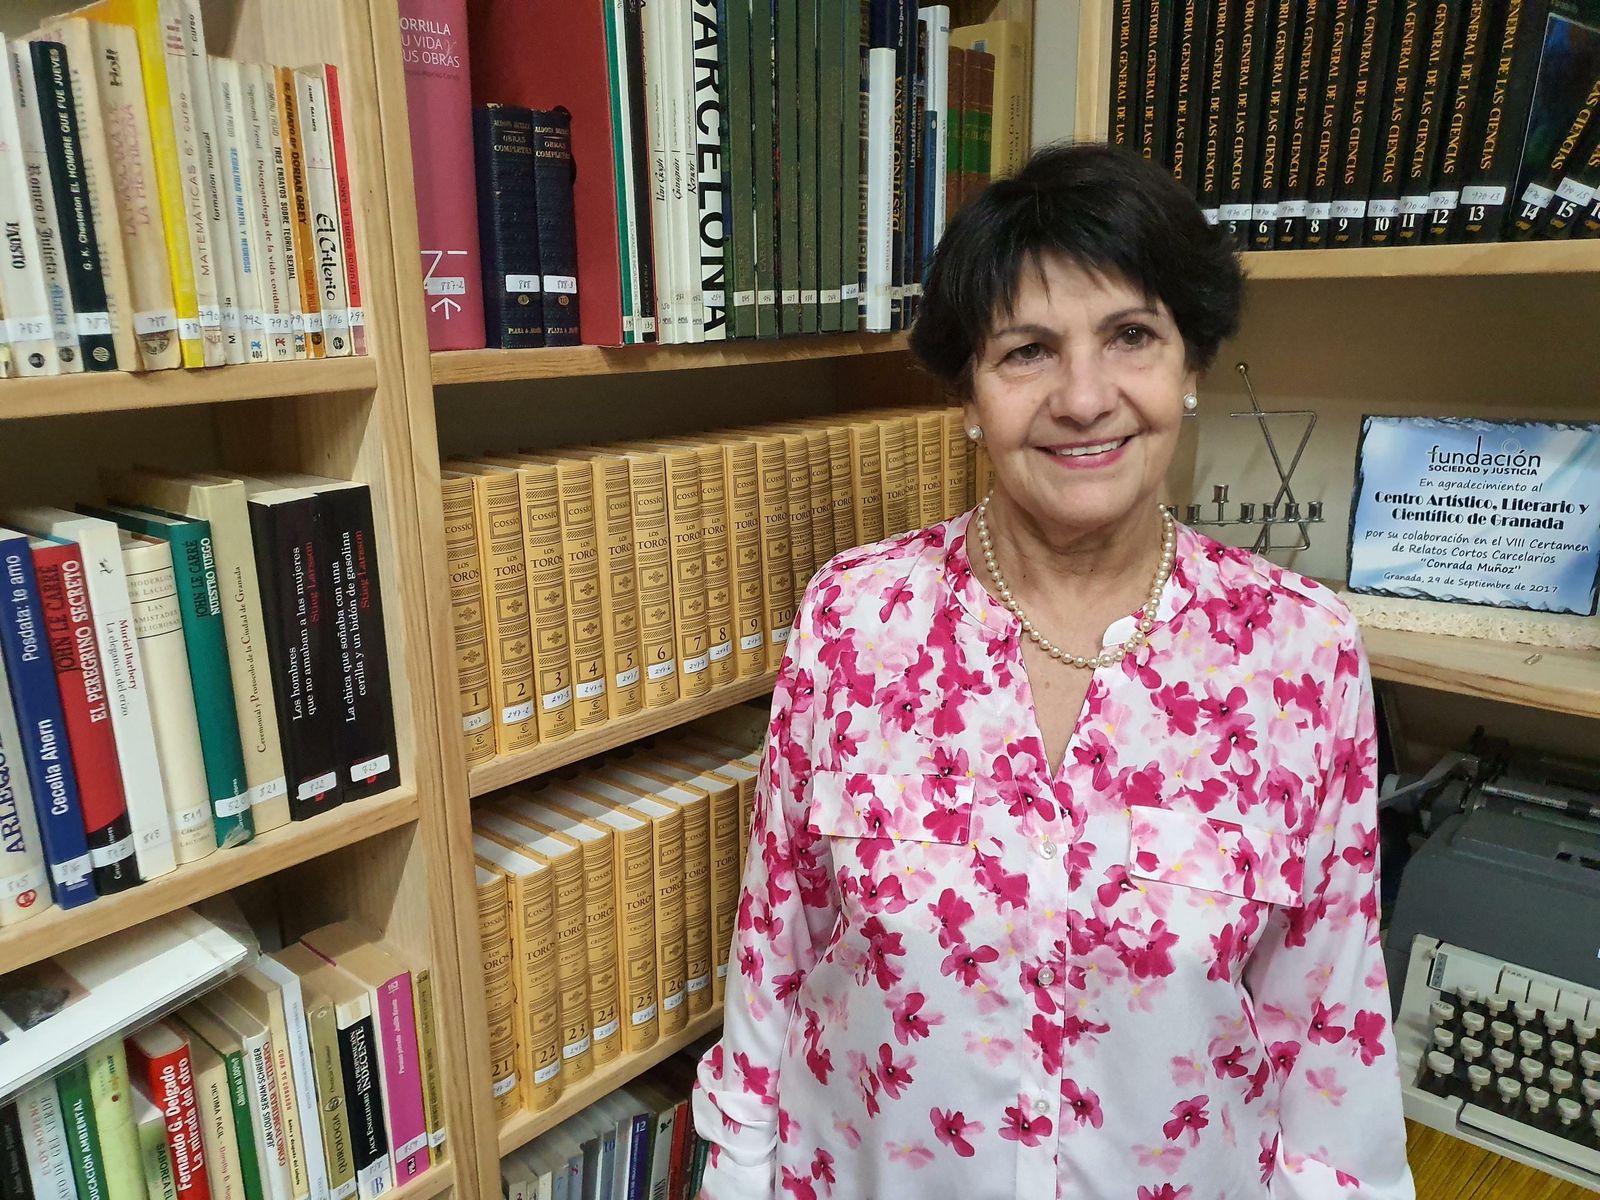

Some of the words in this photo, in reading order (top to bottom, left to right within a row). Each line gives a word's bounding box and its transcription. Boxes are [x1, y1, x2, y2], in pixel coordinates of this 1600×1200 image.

[400, 17, 451, 35] ORRILLA
[1429, 3, 1447, 65] GENERAL
[414, 36, 443, 50] VIDA
[1398, 12, 1416, 73] GENERAL
[50, 48, 64, 86] JUEVES
[422, 51, 460, 68] OBRAS
[1211, 38, 1224, 94] GENERAL
[1239, 33, 1252, 89] GENERAL
[1394, 77, 1407, 94] DE
[1425, 70, 1438, 86] DE
[56, 88, 66, 108] FUE
[1209, 97, 1220, 112] DE
[1237, 93, 1248, 109] DE
[1421, 91, 1434, 115] LAS
[1391, 97, 1404, 121] LAS
[59, 110, 69, 133] QUE
[1208, 115, 1218, 137] LAS
[1235, 112, 1246, 133] LAS
[63, 135, 78, 178] HOMBRE
[273, 146, 283, 166] TRES
[1382, 125, 1400, 182] CIENCIAS
[1410, 118, 1430, 177] CIENCIAS
[1204, 140, 1216, 192] CIENCIAS
[1231, 137, 1244, 190] CIENCIAS
[69, 181, 81, 193] EL
[275, 168, 288, 199] ENSAYOS
[73, 195, 87, 243] Chesterton
[280, 202, 290, 224] SOBRE
[1432, 210, 1449, 223] 12
[1468, 206, 1485, 221] 13
[1521, 204, 1539, 220] 14
[1556, 201, 1578, 217] 15
[316, 213, 335, 232] El
[1259, 221, 1267, 233] 6
[1284, 220, 1292, 232] 7
[1311, 220, 1320, 232] 8
[1339, 219, 1348, 231] 9
[1374, 218, 1389, 231] 10
[1402, 214, 1415, 227] 11
[6, 222, 25, 269] FAUSTO
[286, 255, 295, 280] SEXUAL
[318, 237, 336, 301] Criterio
[1427, 435, 1541, 468] fundación
[1428, 464, 1480, 474] SOCIEDAD
[1491, 467, 1537, 476] JUSTICIA
[1420, 478, 1433, 487] En
[1438, 480, 1526, 491] agradecimiento
[1532, 483, 1543, 492] al
[1375, 491, 1424, 505] Centro
[1426, 494, 1498, 511] Artístico,
[1502, 498, 1575, 513] Literario
[1579, 504, 1589, 515] y
[1392, 508, 1464, 524] Científico
[1467, 513, 1487, 525] de
[1490, 514, 1564, 529] Granada
[636, 536, 668, 549] TOROS
[1365, 530, 1384, 539] por
[1387, 531, 1398, 539] su
[1402, 531, 1469, 543] colaboración
[1474, 537, 1487, 545] en
[1492, 536, 1502, 546] el
[1506, 537, 1526, 547] VIII
[1529, 539, 1589, 551] Certamen
[200, 538, 214, 568] JUEGO
[341, 531, 356, 582] gasolina
[530, 556, 563, 568] TOROS
[1392, 542, 1405, 552] de
[1408, 544, 1447, 556] Relatos
[1451, 547, 1488, 558] Cortos
[1492, 550, 1556, 564] Carcelarios
[6, 555, 25, 586] amo
[293, 547, 305, 596] mujeres
[331, 561, 341, 583] una
[62, 560, 89, 622] SECRETO
[346, 583, 356, 599] de
[1384, 572, 1424, 583] Granada,
[1444, 577, 1454, 585] de
[1458, 579, 1511, 589] Septiembre
[1514, 583, 1525, 591] de
[1529, 584, 1558, 593] 2017
[205, 571, 220, 615] NUESTRO
[336, 586, 344, 607] con
[296, 599, 306, 615] las
[348, 602, 360, 631] bidón
[778, 610, 791, 622] 10
[300, 617, 307, 626] a
[336, 610, 348, 649] soñaba
[751, 618, 758, 632] 9
[17, 605, 40, 662] Posdata:
[119, 619, 133, 653] Muriel
[352, 633, 362, 650] un
[694, 637, 701, 650] 7
[719, 627, 726, 640] 8
[300, 629, 312, 675] amaban
[355, 650, 364, 661] y
[626, 653, 633, 667] 5
[657, 646, 666, 660] 6
[76, 627, 105, 703] PEREGRINO
[125, 653, 138, 690] Barbery
[289, 647, 300, 697] hombres
[341, 653, 352, 673] que
[589, 661, 598, 676] 4
[305, 679, 313, 695] no
[342, 674, 353, 704] chica
[354, 662, 366, 696] cerilla
[555, 672, 561, 687] 3
[472, 692, 479, 706] 1
[517, 683, 526, 696] 2
[90, 703, 107, 723] EL
[292, 700, 303, 720] Los
[308, 700, 316, 716] que
[346, 706, 356, 722] La
[38, 718, 58, 760] Ahern
[45, 765, 67, 816] Cecelia
[637, 992, 652, 1008] 25
[598, 1006, 613, 1023] 24
[568, 1024, 585, 1040] 23
[540, 1045, 556, 1063] 22
[177, 1058, 190, 1084] otro
[160, 1065, 180, 1117] Delgado
[180, 1085, 194, 1106] del
[74, 1098, 91, 1153] AMBIENTAL
[168, 1117, 183, 1132] G.
[184, 1107, 201, 1151] mirada
[636, 1122, 646, 1132] 12
[171, 1133, 192, 1191] Fernando
[191, 1152, 203, 1172] La
